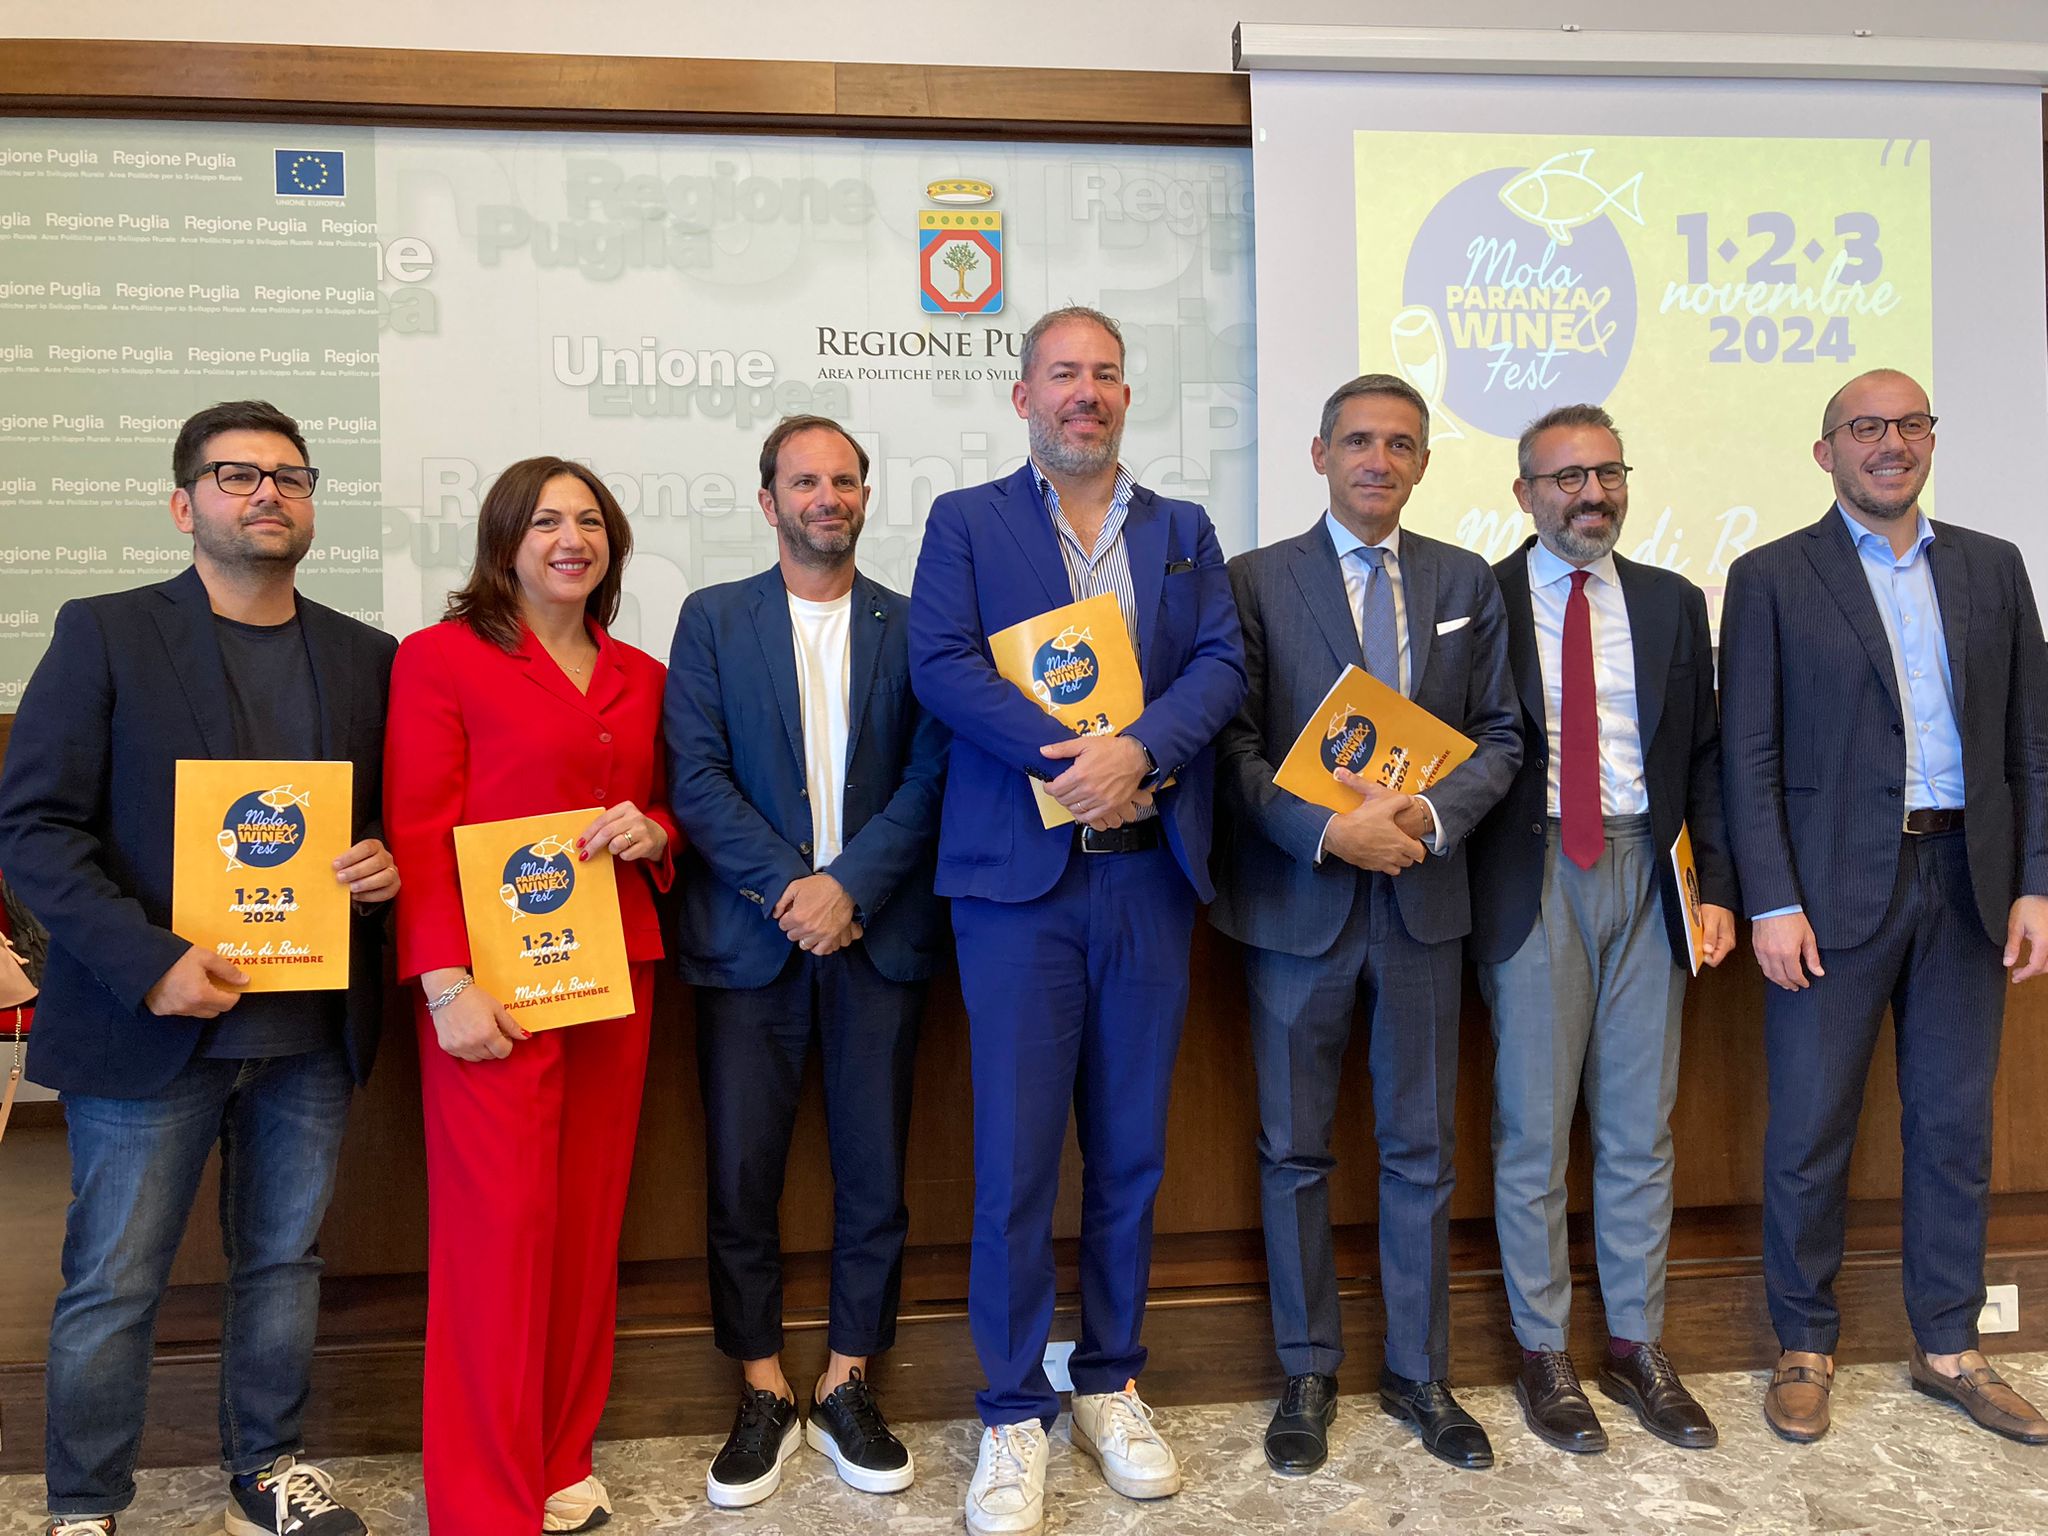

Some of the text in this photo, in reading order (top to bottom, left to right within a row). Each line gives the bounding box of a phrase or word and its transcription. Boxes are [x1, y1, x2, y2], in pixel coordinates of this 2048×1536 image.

[48, 149, 98, 167] Puglia
[113, 150, 181, 168] Regione
[185, 152, 236, 170] Puglia
[276, 199, 345, 208] UNIONE EUROPEA
[0, 212, 377, 236] glia Regione Puglia Regione Puglia Region
[1463, 235, 1583, 290] Mola
[1659, 248, 1902, 317] novembre
[50, 282, 100, 299] Puglia
[117, 283, 184, 301] Regione
[189, 285, 240, 302] Puglia
[255, 286, 321, 303] Regione
[326, 287, 375, 304] Puglia
[1446, 285, 1593, 310] PARANZA
[1447, 312, 1577, 349] WINE
[1709, 315, 1857, 364] 2024
[816, 327, 972, 357] REGIONE
[49, 346, 117, 363] Regione
[122, 346, 173, 364] Puglia
[188, 348, 256, 365] Regione
[260, 349, 310, 366] Puglia
[325, 350, 379, 366] Region
[552, 336, 775, 387] Unione
[818, 368, 854, 379] AREA
[858, 368, 932, 380] POLITICHE
[936, 369, 960, 380] PER
[965, 370, 982, 380] LO
[1483, 339, 1569, 393] Fest
[0, 414, 48, 431] gione
[53, 415, 104, 432] Puglia
[328, 417, 377, 433] Puglia
[51, 478, 121, 495] Regione
[125, 478, 176, 496] Puglia
[327, 479, 382, 496] Region
[56, 547, 107, 564] Puglia
[122, 547, 191, 564] Regione
[330, 546, 379, 563] Puglia
[1046, 651, 1081, 669] Mola
[1060, 680, 1082, 696] Fest
[1331, 729, 1355, 757] Mola
[1352, 742, 1367, 764] Fest
[1394, 760, 1410, 791] 2024
[1425, 749, 1451, 789] ETTEMBRE
[237, 823, 289, 832] PARANZA
[245, 809, 287, 827] Mola
[238, 831, 285, 843] WINE
[250, 840, 280, 855] Fest
[515, 871, 560, 884] PARANZA
[520, 861, 557, 877] Mola
[517, 878, 558, 894] WINE
[228, 894, 300, 913] novembre
[529, 888, 554, 904] Fest
[243, 911, 286, 924] 2024
[216, 940, 311, 957] Mola di Bari
[519, 938, 581, 960] novembre
[243, 957, 257, 965] XX
[260, 955, 324, 965] SETTEMBRE
[532, 951, 570, 967] 2024
[503, 985, 610, 1011] PIAZZA XX SETTEMBRE
[515, 976, 597, 1001] Mola di Bari
